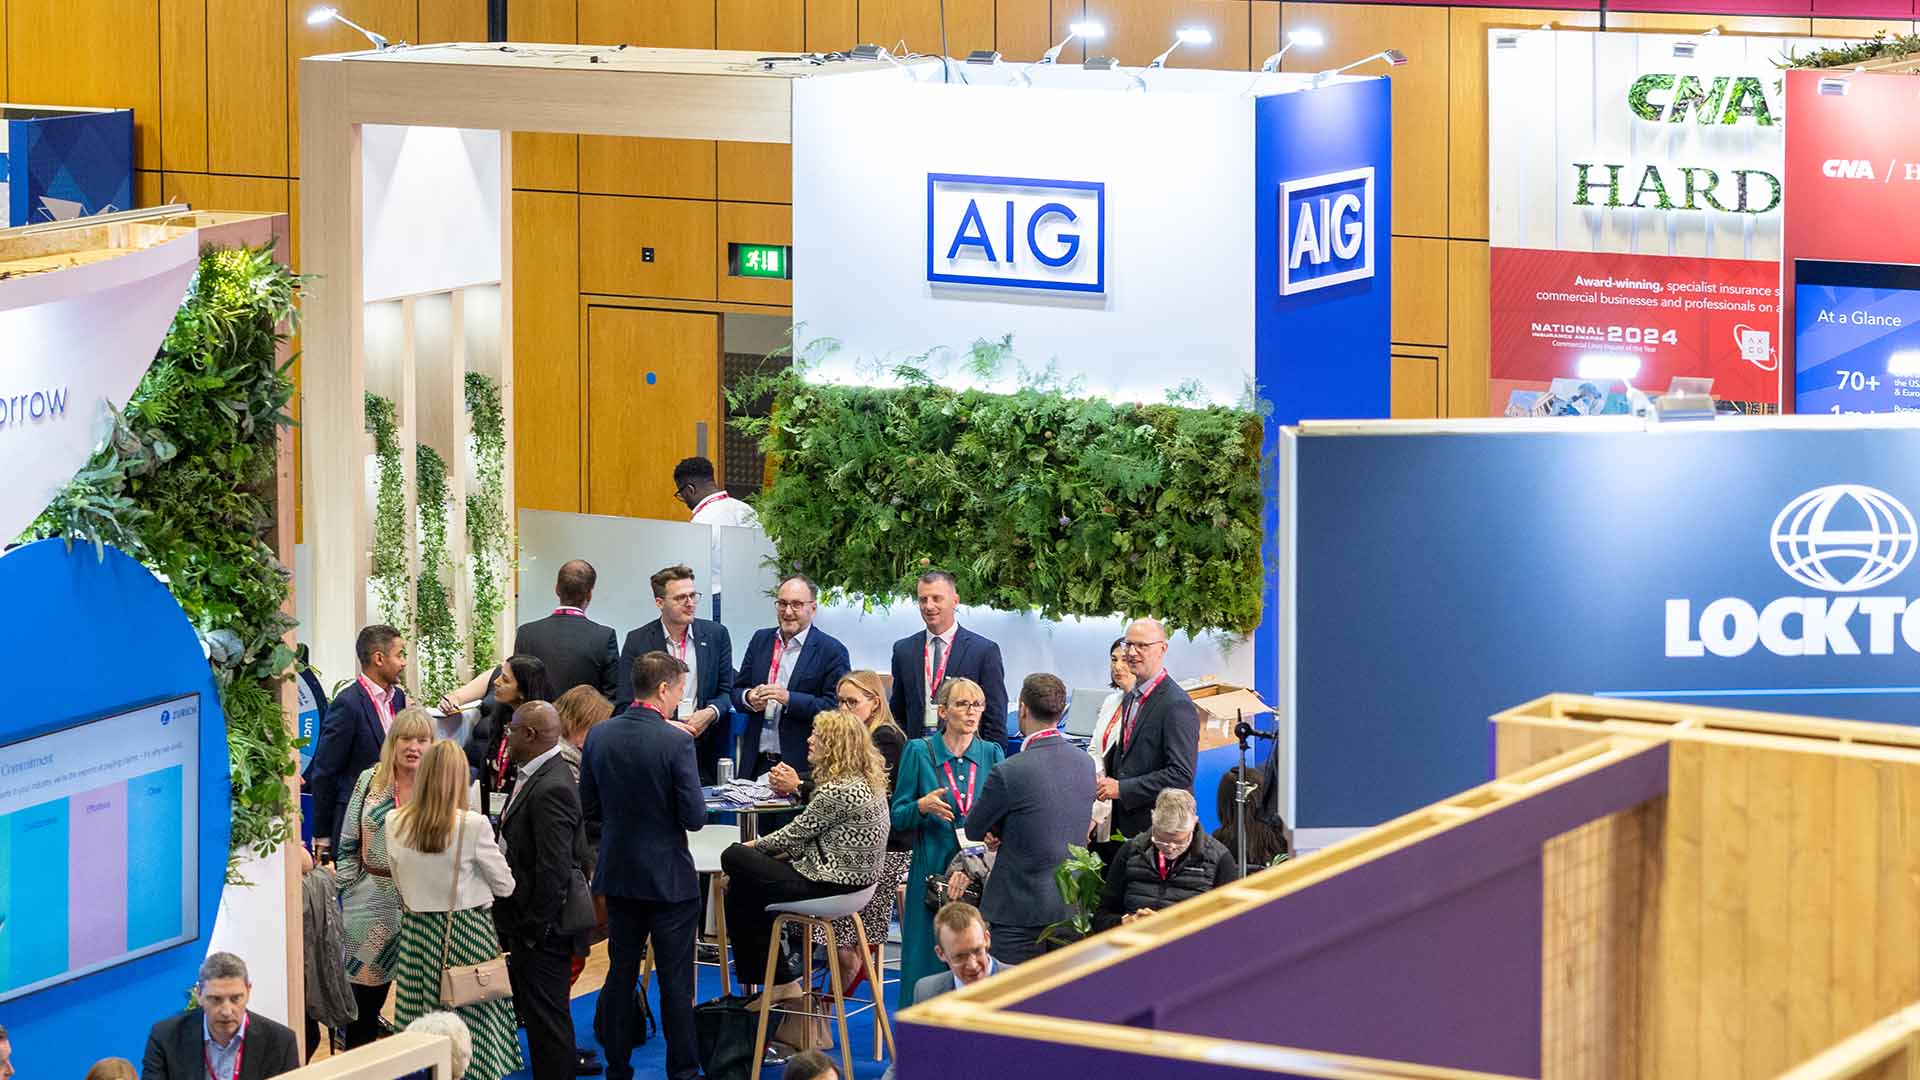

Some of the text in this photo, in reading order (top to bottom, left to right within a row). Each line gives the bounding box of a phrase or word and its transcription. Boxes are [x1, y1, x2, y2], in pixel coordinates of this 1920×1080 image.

[1628, 73, 1773, 126] CNA
[1822, 159, 1875, 179] CNA
[1573, 163, 1782, 215] HARD
[947, 199, 1081, 268] AIG
[1289, 193, 1364, 269] AIG
[1574, 275, 1664, 293] Award-winning,
[1666, 280, 1717, 295] specialist
[1720, 283, 1771, 297] insurance
[1536, 290, 1598, 304] commercial
[1600, 294, 1658, 307] businesses
[1661, 296, 1682, 308] and
[1685, 298, 1756, 312] professionals
[1758, 303, 1773, 313] on
[1531, 322, 1605, 336] NATIONAL
[1817, 309, 1902, 327] At a Glance
[1607, 326, 1678, 345] 2024
[1836, 370, 1881, 391] 70+
